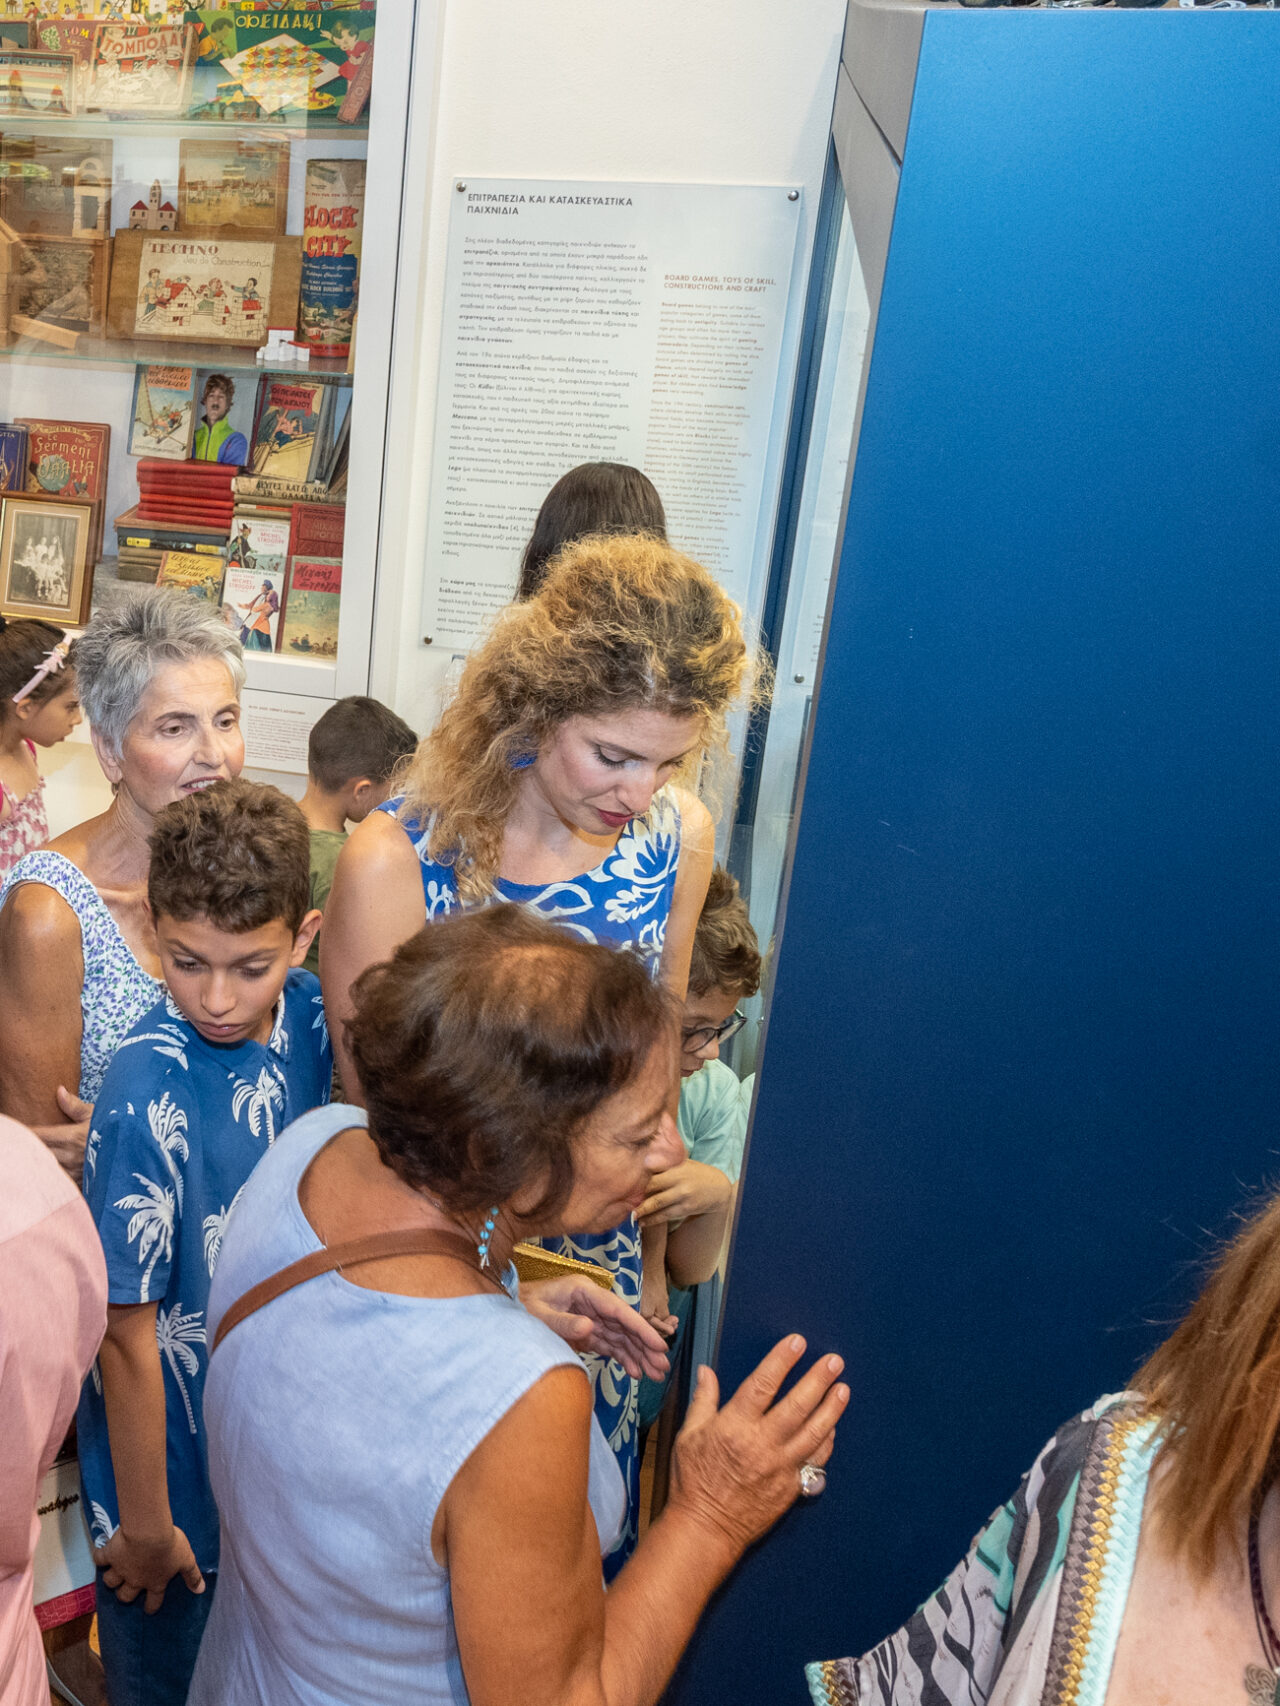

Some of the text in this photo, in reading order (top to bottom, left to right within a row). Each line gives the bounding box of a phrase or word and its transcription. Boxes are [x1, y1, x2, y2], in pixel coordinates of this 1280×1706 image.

[467, 193, 634, 207] ΕΠΙΤΡΑΠΕΖΙΑ ΚΑΙ ΚΑΤΑΣΚΕΥΑΣΤΙΚΑ
[466, 205, 520, 216] ΠΑΙΧΝΙΔΙΑ
[304, 204, 359, 230] BLOCK
[148, 242, 219, 256] TECHNO
[306, 235, 352, 258] CITY
[664, 282, 723, 290] CONSTRUCTIONS
[260, 532, 282, 541] MICHEL
[228, 582, 256, 591] STROGOFF
[231, 577, 253, 586] MICHEL
